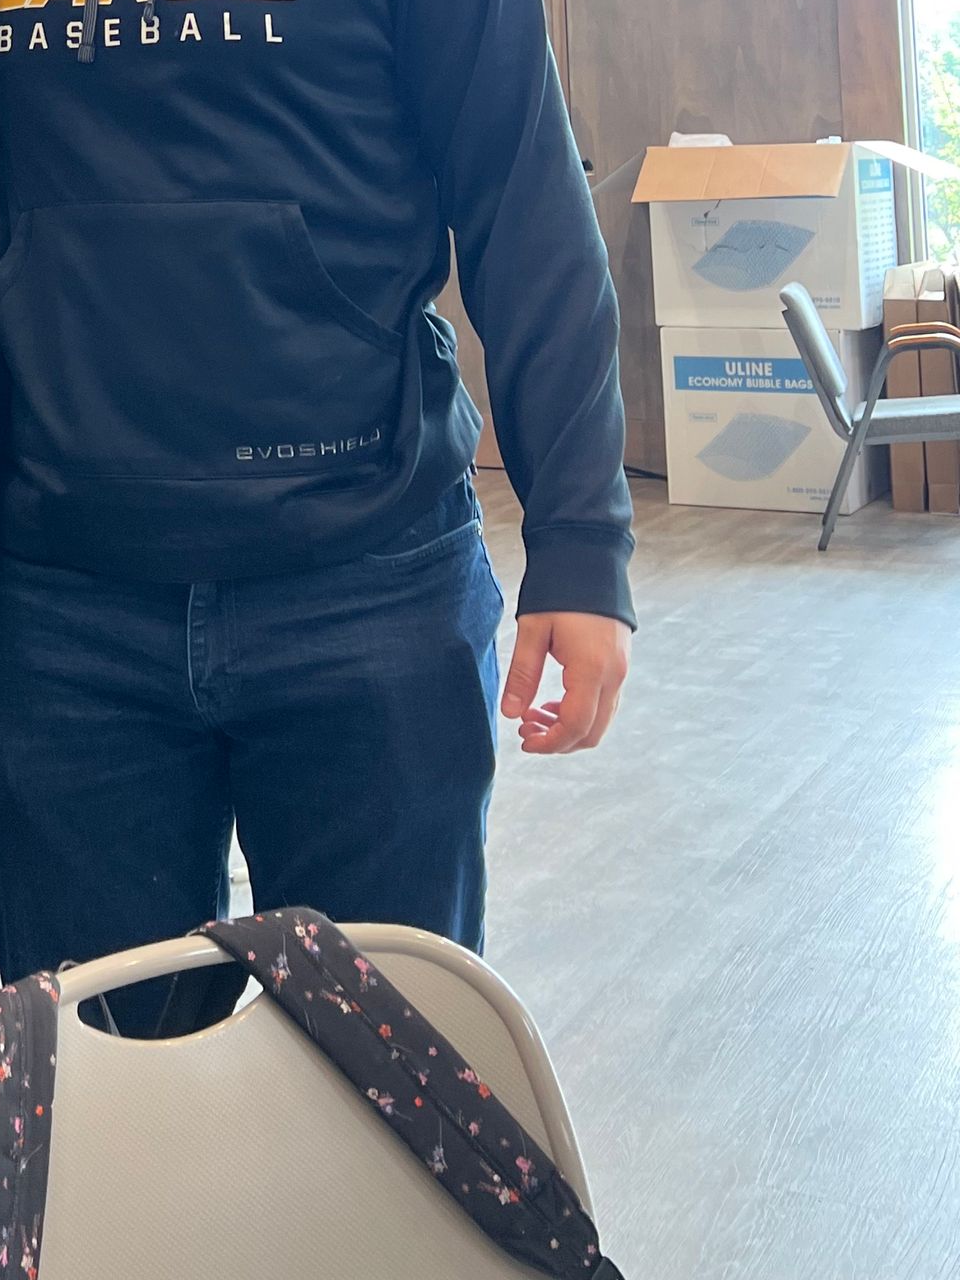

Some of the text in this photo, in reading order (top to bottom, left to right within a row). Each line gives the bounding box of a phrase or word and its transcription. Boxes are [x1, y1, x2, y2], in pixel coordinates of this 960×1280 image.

[724, 361, 773, 376] ULINE
[688, 376, 813, 390] ECONOMY BUBBLE BAGS
